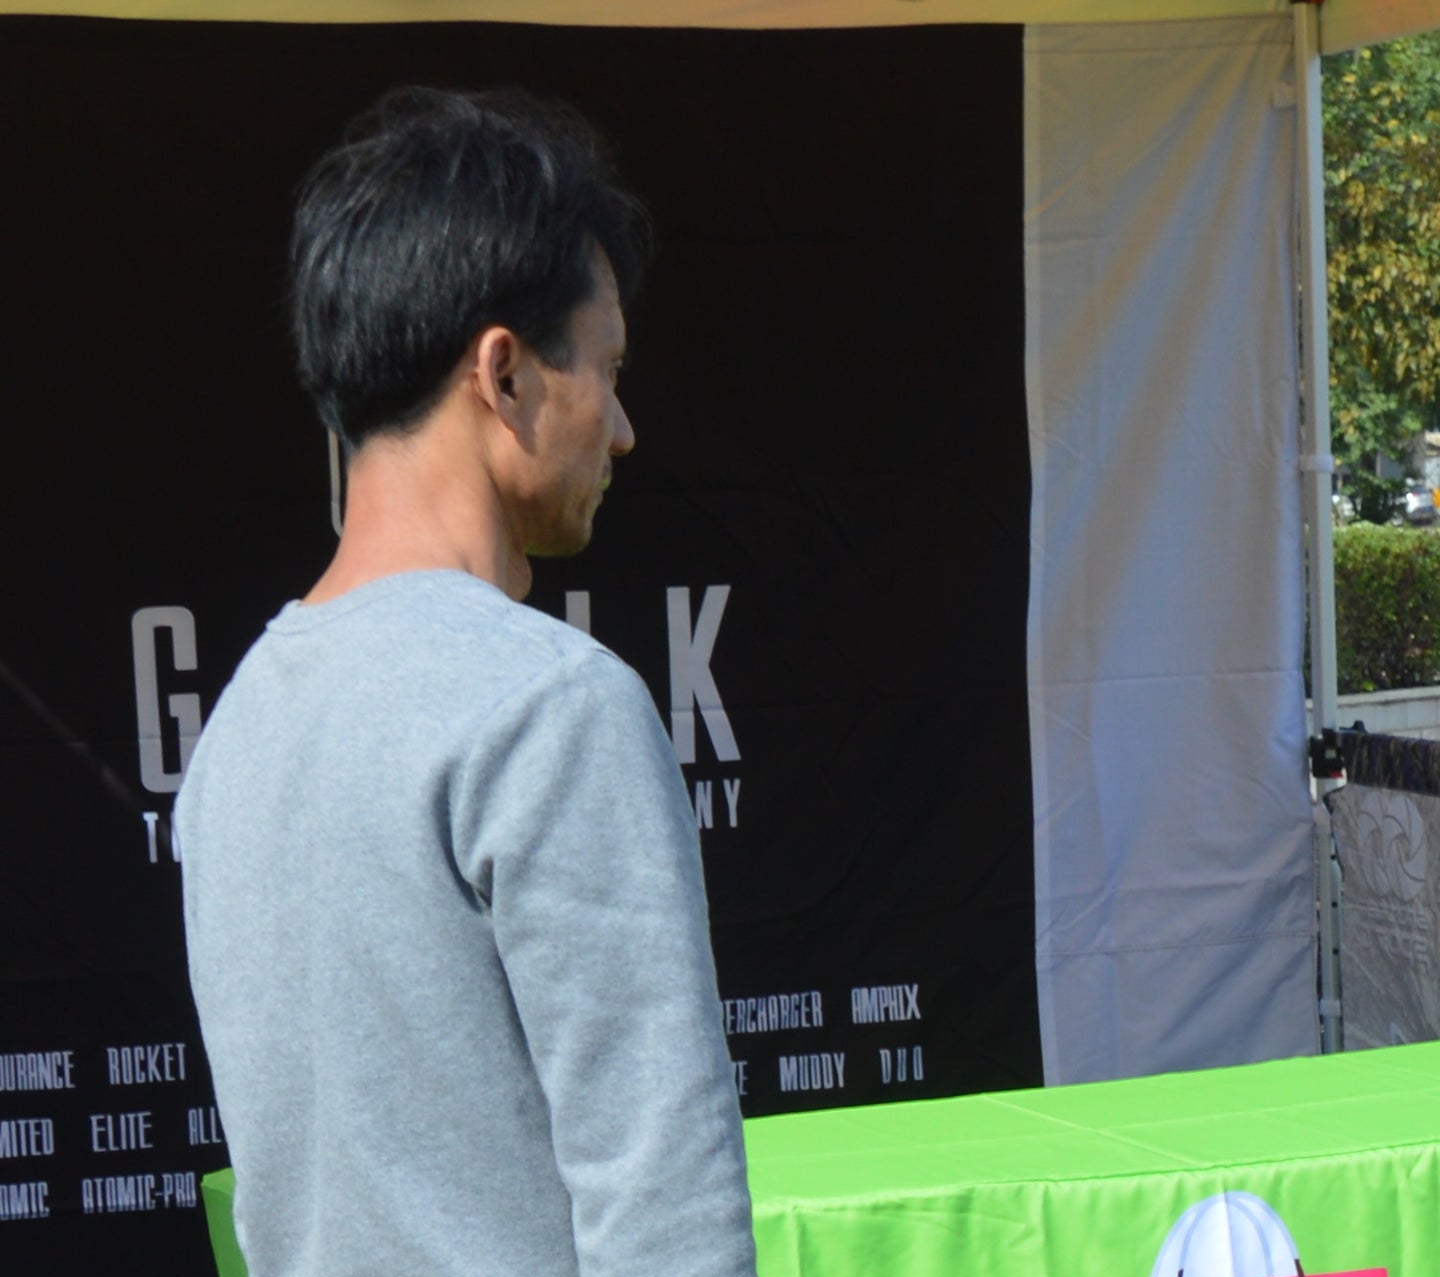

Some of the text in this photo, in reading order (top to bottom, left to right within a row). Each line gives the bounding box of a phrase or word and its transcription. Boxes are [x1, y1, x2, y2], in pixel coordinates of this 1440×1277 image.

[107, 1043, 186, 1085] ROCKET
[721, 991, 824, 1036] ERCHARGER
[851, 984, 921, 1024] AMPHIX
[89, 1112, 153, 1152] ELITE
[778, 1052, 846, 1092] MUDDY
[82, 1171, 197, 1214] ATOMIC-PRO
